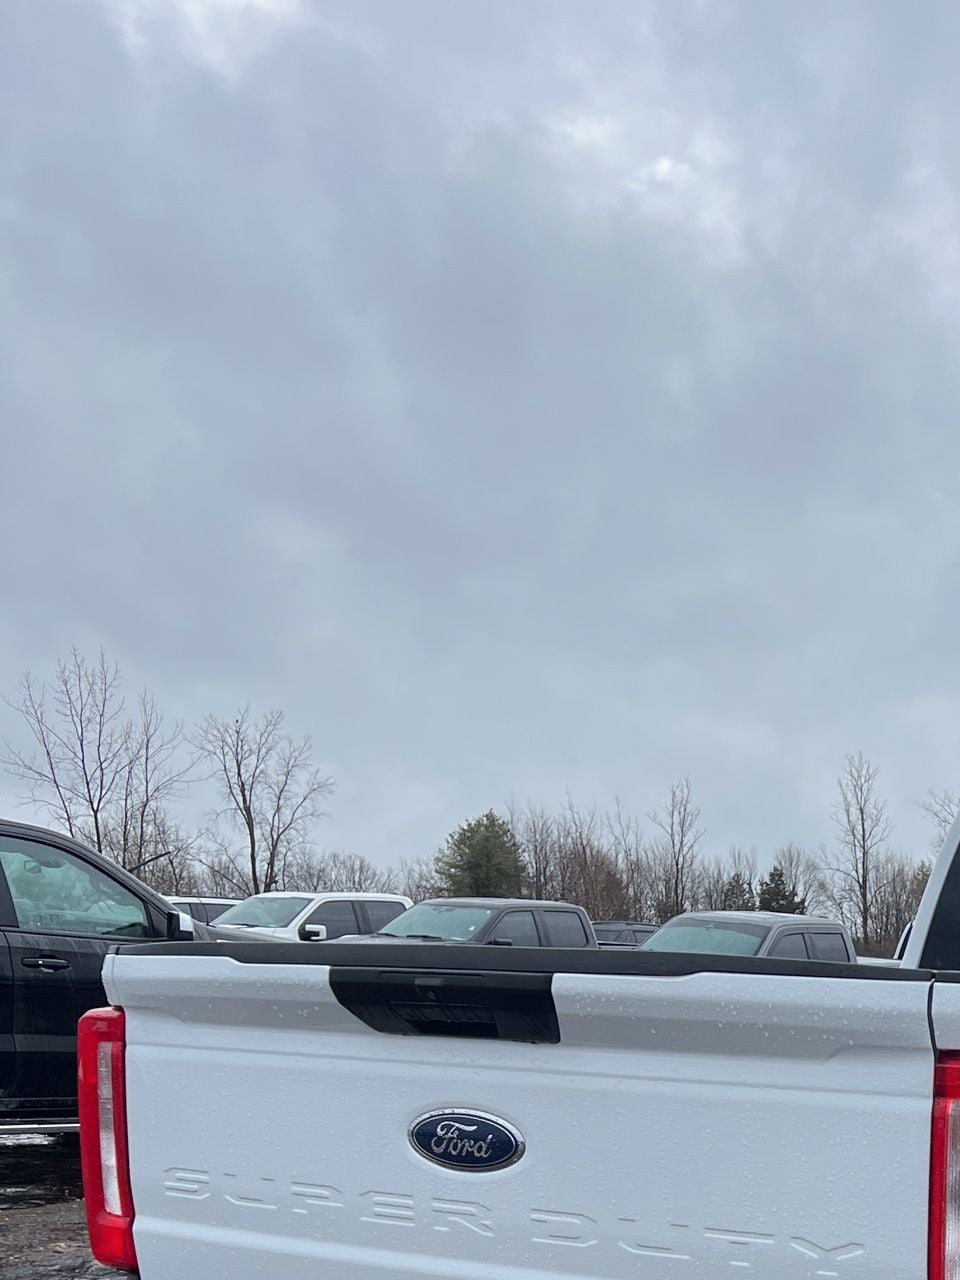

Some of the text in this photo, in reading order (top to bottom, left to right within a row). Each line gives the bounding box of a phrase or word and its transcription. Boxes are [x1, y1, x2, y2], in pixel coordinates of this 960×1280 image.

[430, 1121, 494, 1158] Ford
[163, 1167, 865, 1276] SUPER DUTY
